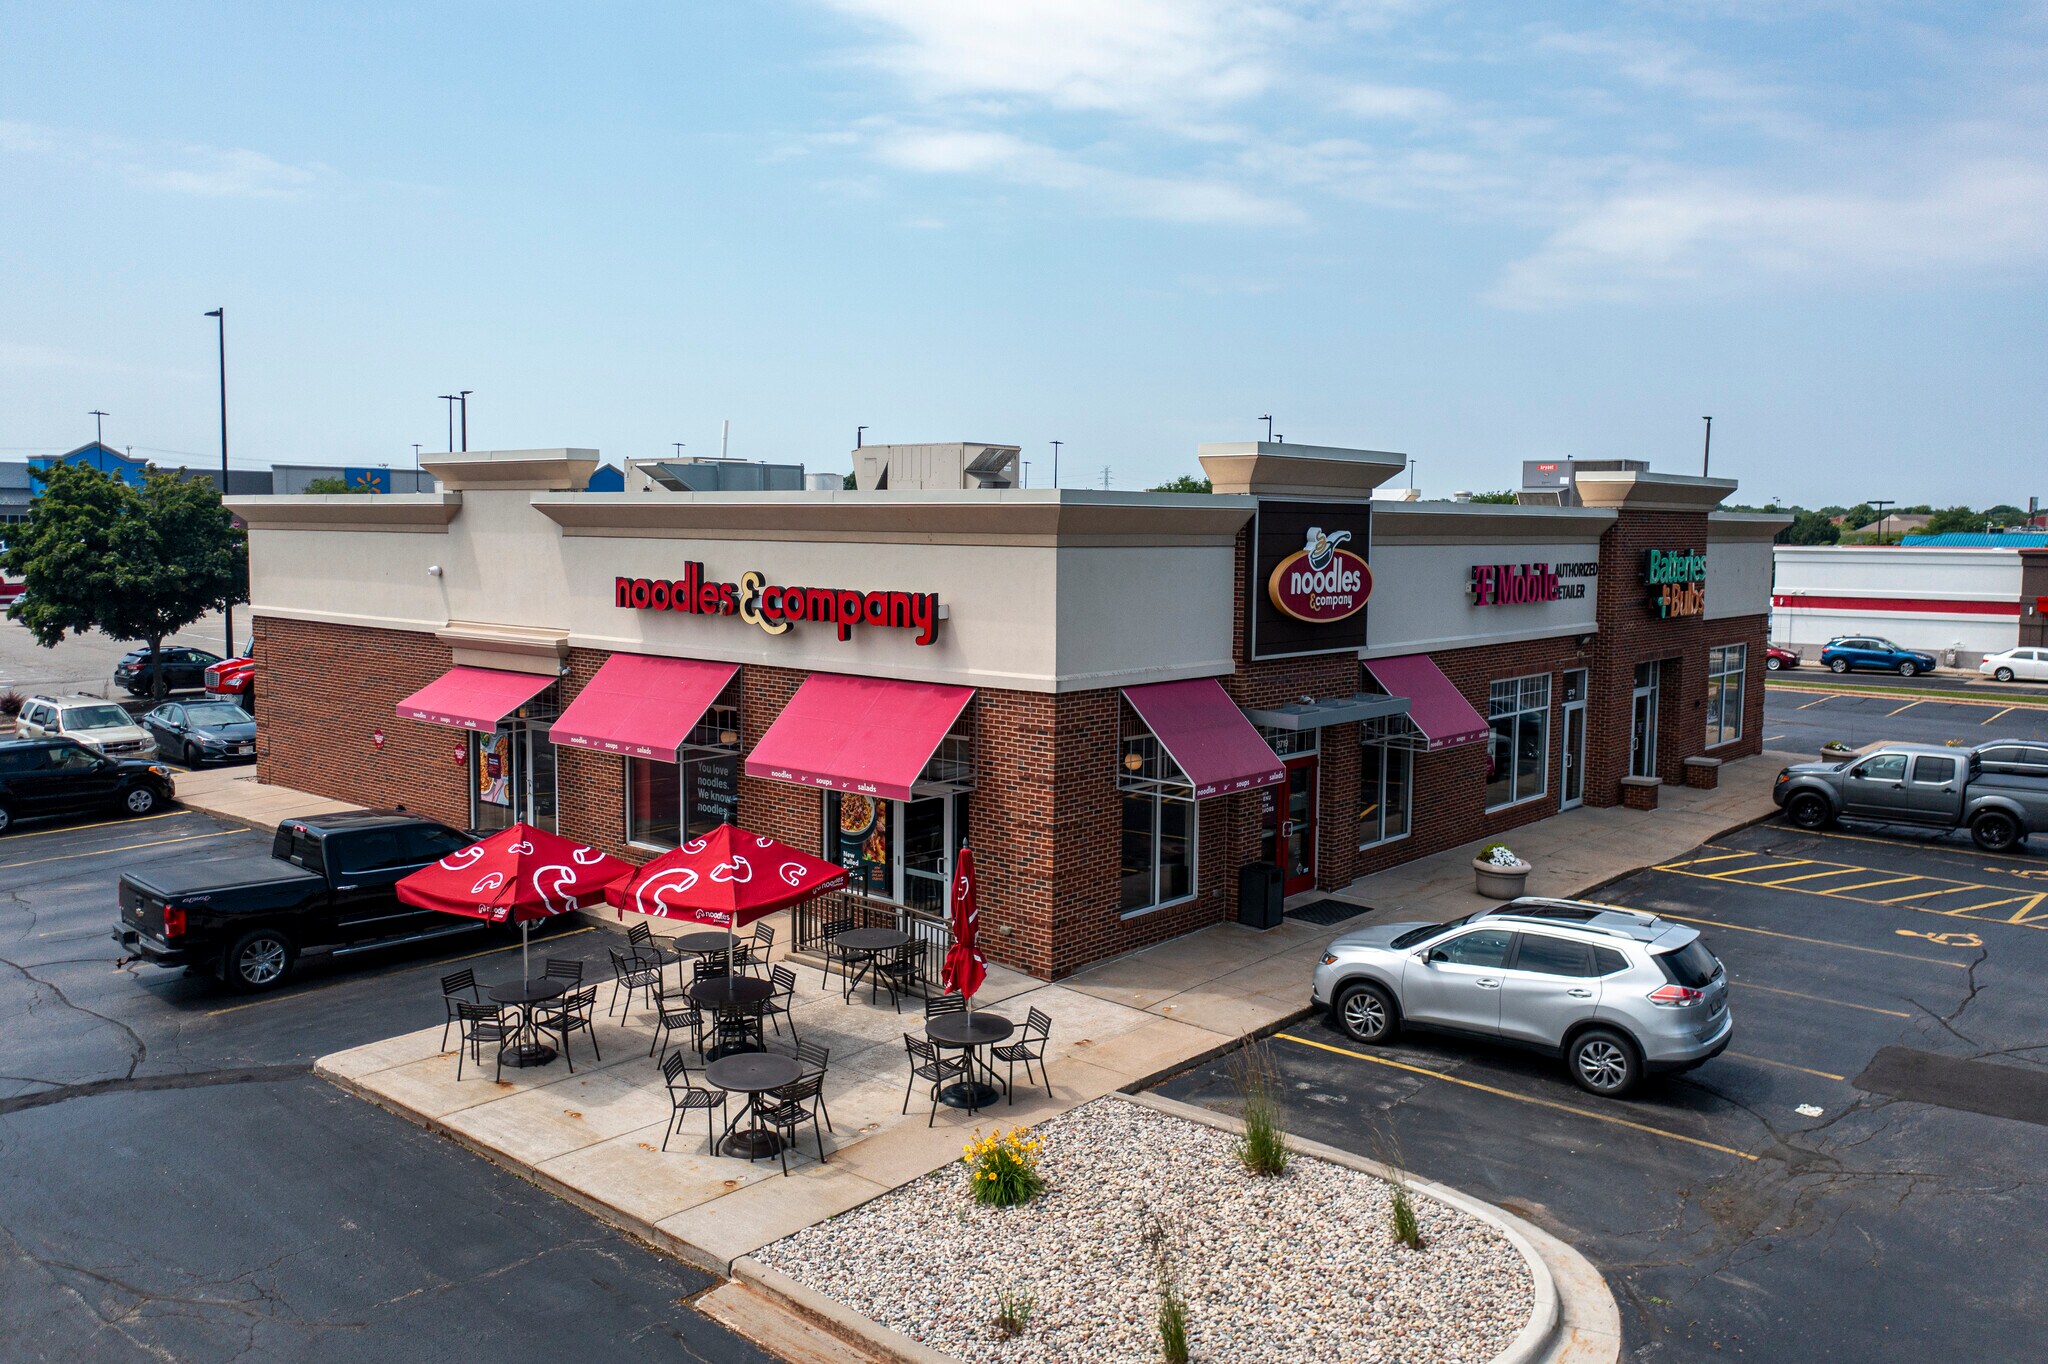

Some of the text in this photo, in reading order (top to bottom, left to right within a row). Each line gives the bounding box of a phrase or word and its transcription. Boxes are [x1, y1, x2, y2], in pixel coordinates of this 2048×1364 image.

[1555, 562, 1598, 578] AUTHORIZED
[1650, 548, 1706, 584] Batteries
[1291, 556, 1361, 595] noodles
[616, 560, 938, 646] noodles & company
[1309, 593, 1353, 611] & company
[1671, 582, 1705, 617] Bulbs
[570, 736, 652, 755] noodles soups salads
[697, 761, 729, 776] You love
[697, 777, 730, 790] noodles.
[771, 770, 877, 793] noodles soups salads
[1197, 771, 1284, 796] noodles soups salads
[697, 787, 732, 803] We know
[697, 803, 730, 817] noodles.
[843, 850, 855, 858] New
[843, 858, 859, 866] Pulled
[705, 911, 730, 921] noodles
